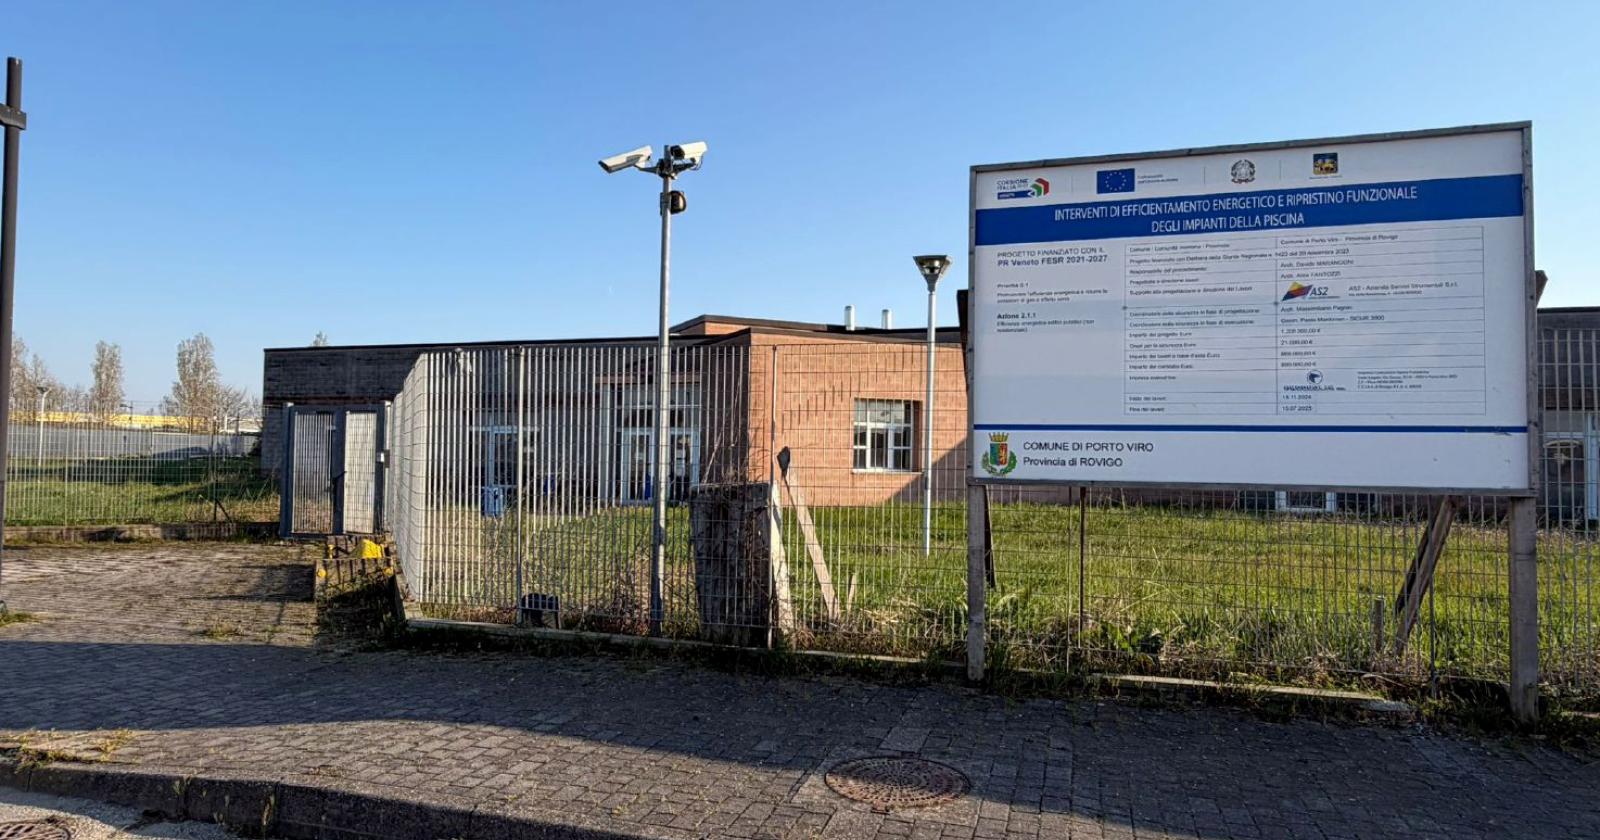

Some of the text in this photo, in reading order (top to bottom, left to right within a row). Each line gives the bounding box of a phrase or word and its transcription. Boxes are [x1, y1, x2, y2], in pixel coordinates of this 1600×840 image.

[1054, 186, 1418, 221] INTERVENTI DI EFFICIENTAMENTO ENERGETICO E RIPRISTINO FUNZIONALE
[1151, 212, 1304, 233] DEGLI IMPIANTI DELLA PISCINA
[997, 250, 1036, 258] PROGETTO
[1037, 248, 1079, 256] FINANZIATO
[997, 254, 1108, 267] PR Veneto FESR 2021-2027
[1310, 286, 1329, 296] AS2
[1023, 442, 1154, 452] COMUNE DI PORTO VIRO
[1023, 457, 1123, 467] Provincia di ROVIGO
